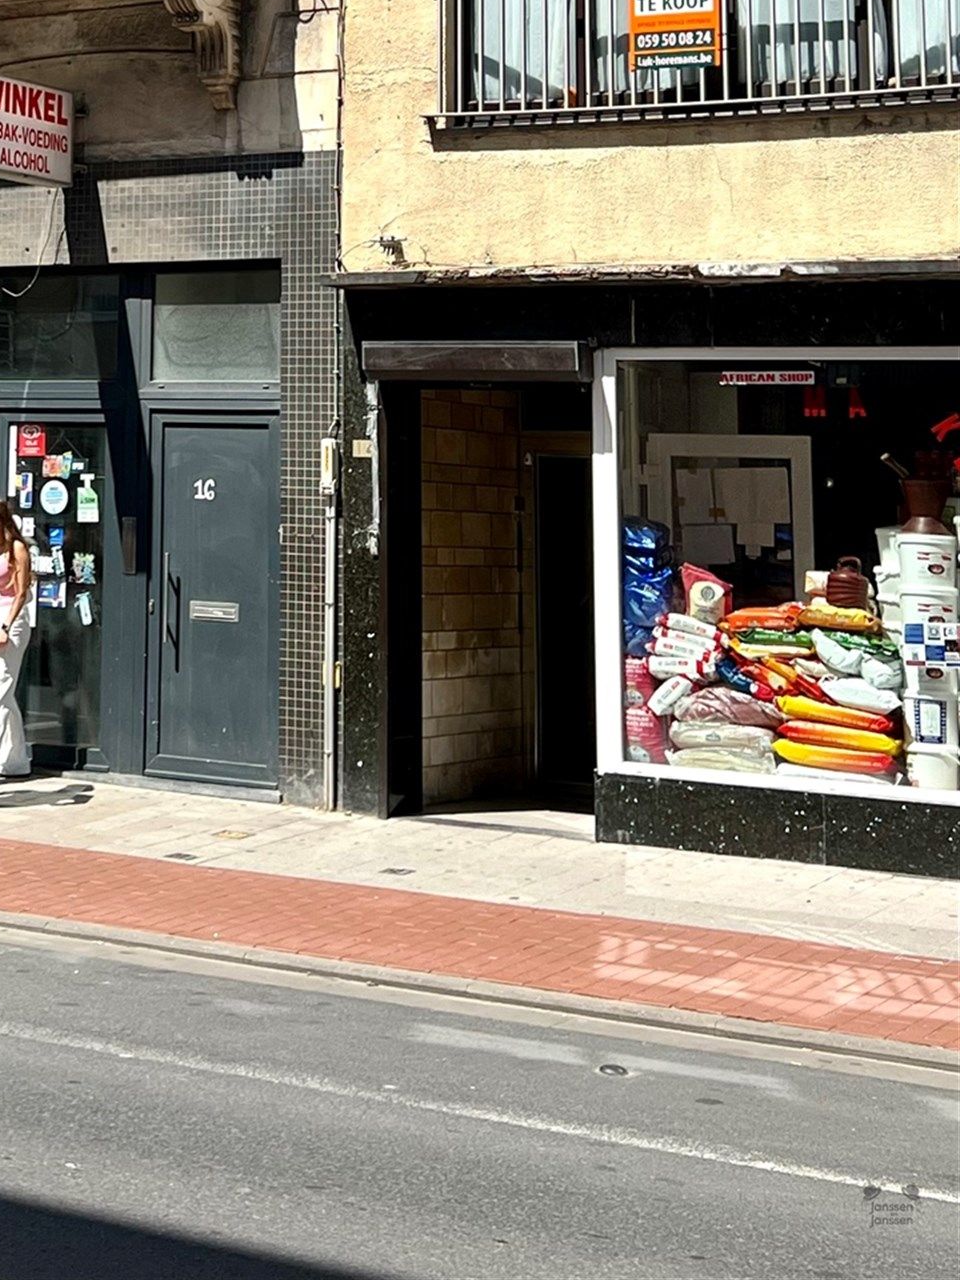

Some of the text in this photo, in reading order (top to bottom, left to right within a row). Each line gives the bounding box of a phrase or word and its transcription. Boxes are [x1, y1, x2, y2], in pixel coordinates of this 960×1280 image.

[637, 30, 712, 48] 059 50 08 24
[0, 147, 51, 174] ALCOHOL
[720, 373, 813, 383] AFRICAN SHOP
[193, 478, 215, 501] 16
